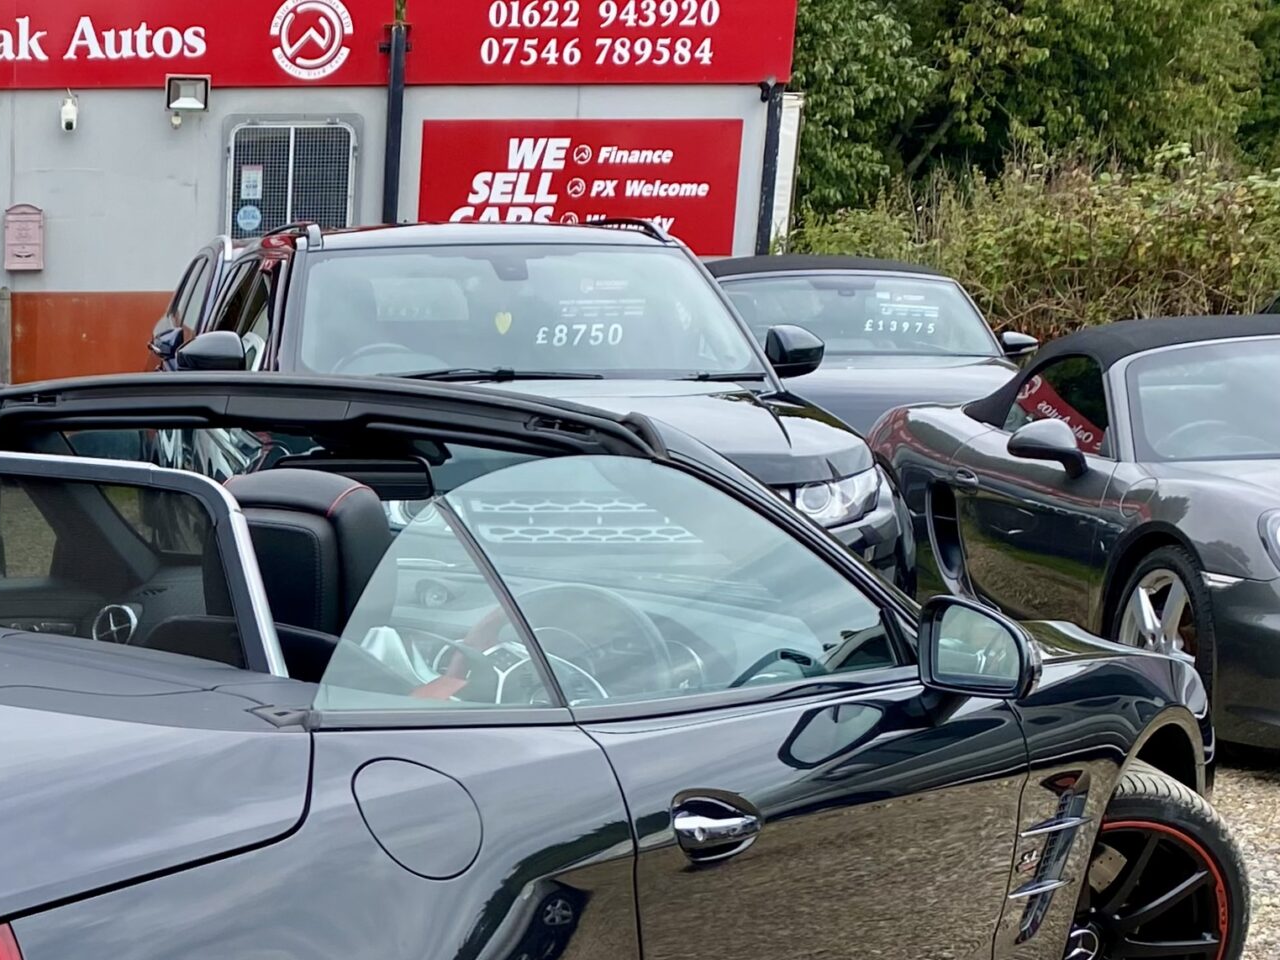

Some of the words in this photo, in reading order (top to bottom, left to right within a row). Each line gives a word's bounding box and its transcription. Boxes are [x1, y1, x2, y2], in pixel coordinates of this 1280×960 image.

[488, 0, 580, 28] 01622
[599, 0, 720, 27] 943920
[63, 16, 206, 61] Autos
[480, 37, 581, 66] 07546
[595, 37, 714, 66] 789584
[507, 138, 571, 170] WE
[597, 147, 673, 164] Finance
[467, 172, 558, 204] SELL
[590, 180, 617, 197] PX
[625, 180, 710, 198] Welcome
[536, 323, 623, 347] £8750
[864, 319, 935, 334] £13975
